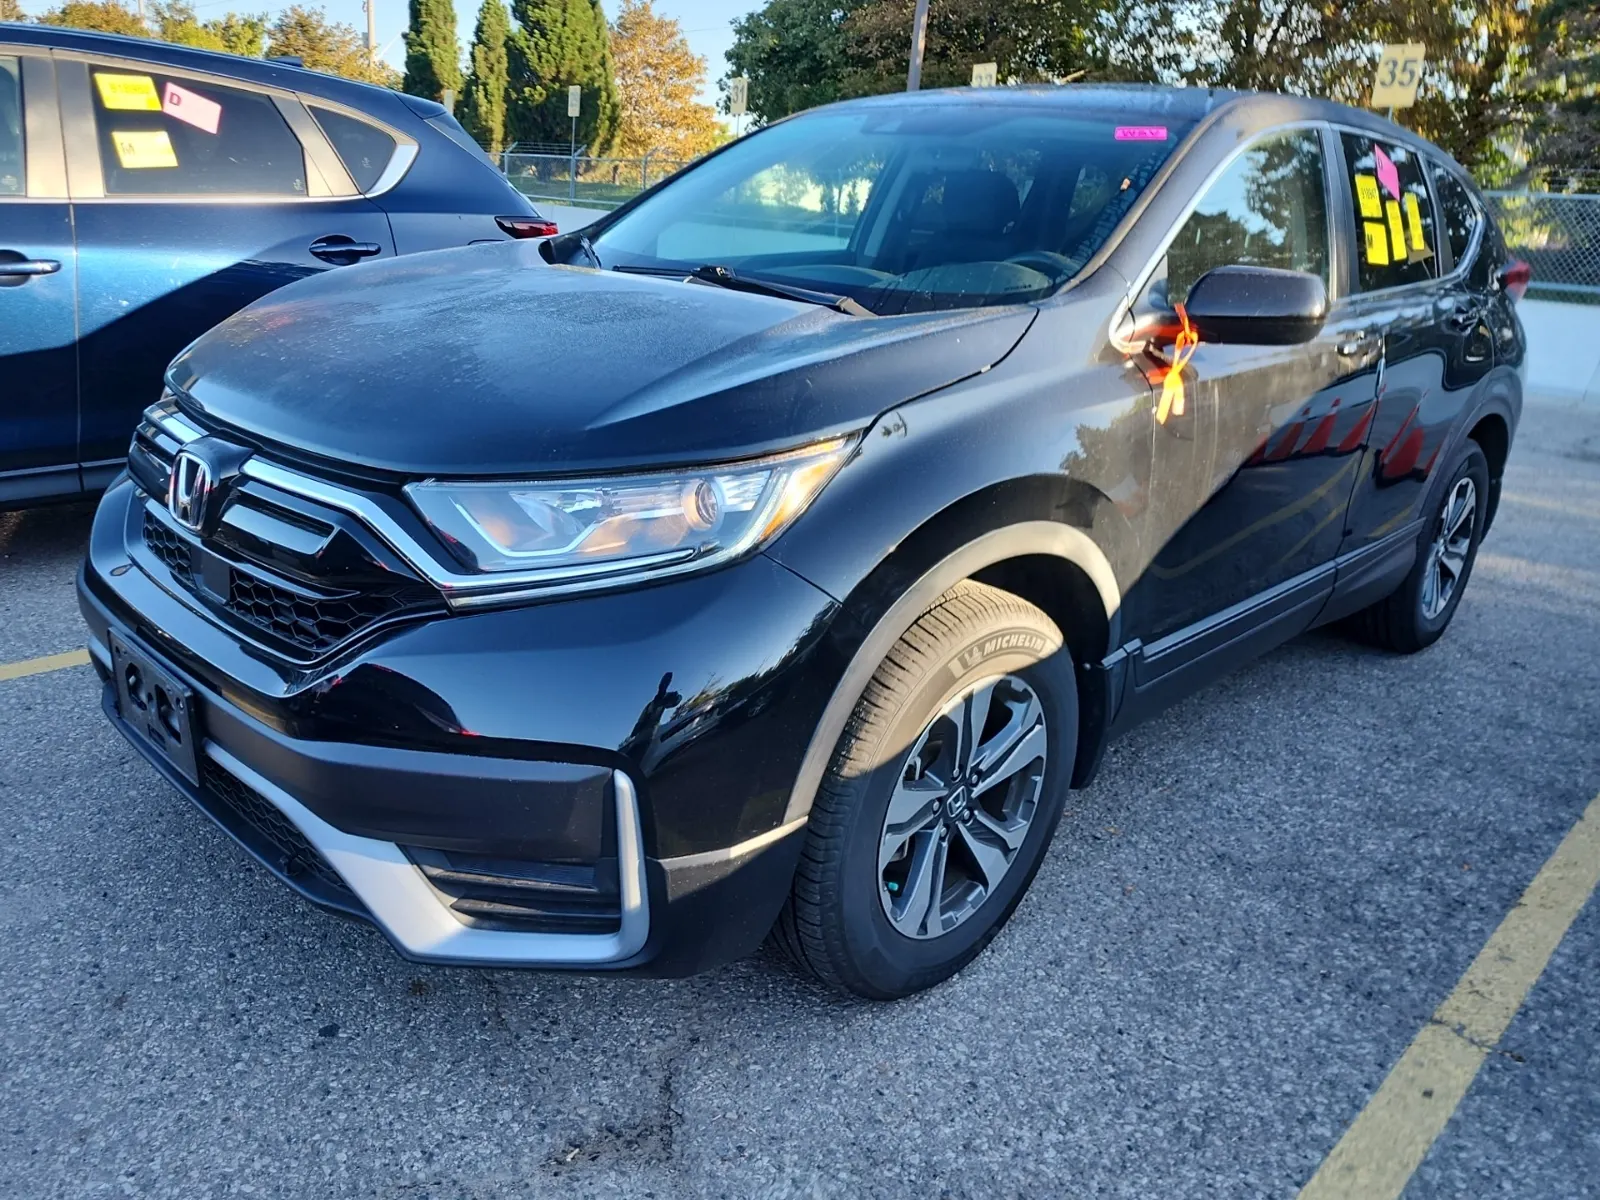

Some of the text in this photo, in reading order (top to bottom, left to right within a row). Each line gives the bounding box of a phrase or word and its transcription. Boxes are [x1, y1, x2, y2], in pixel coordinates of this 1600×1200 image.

[1380, 57, 1418, 87] 35
[168, 92, 181, 106] D
[732, 84, 746, 104] 31
[983, 633, 1044, 656] MICHELIN
